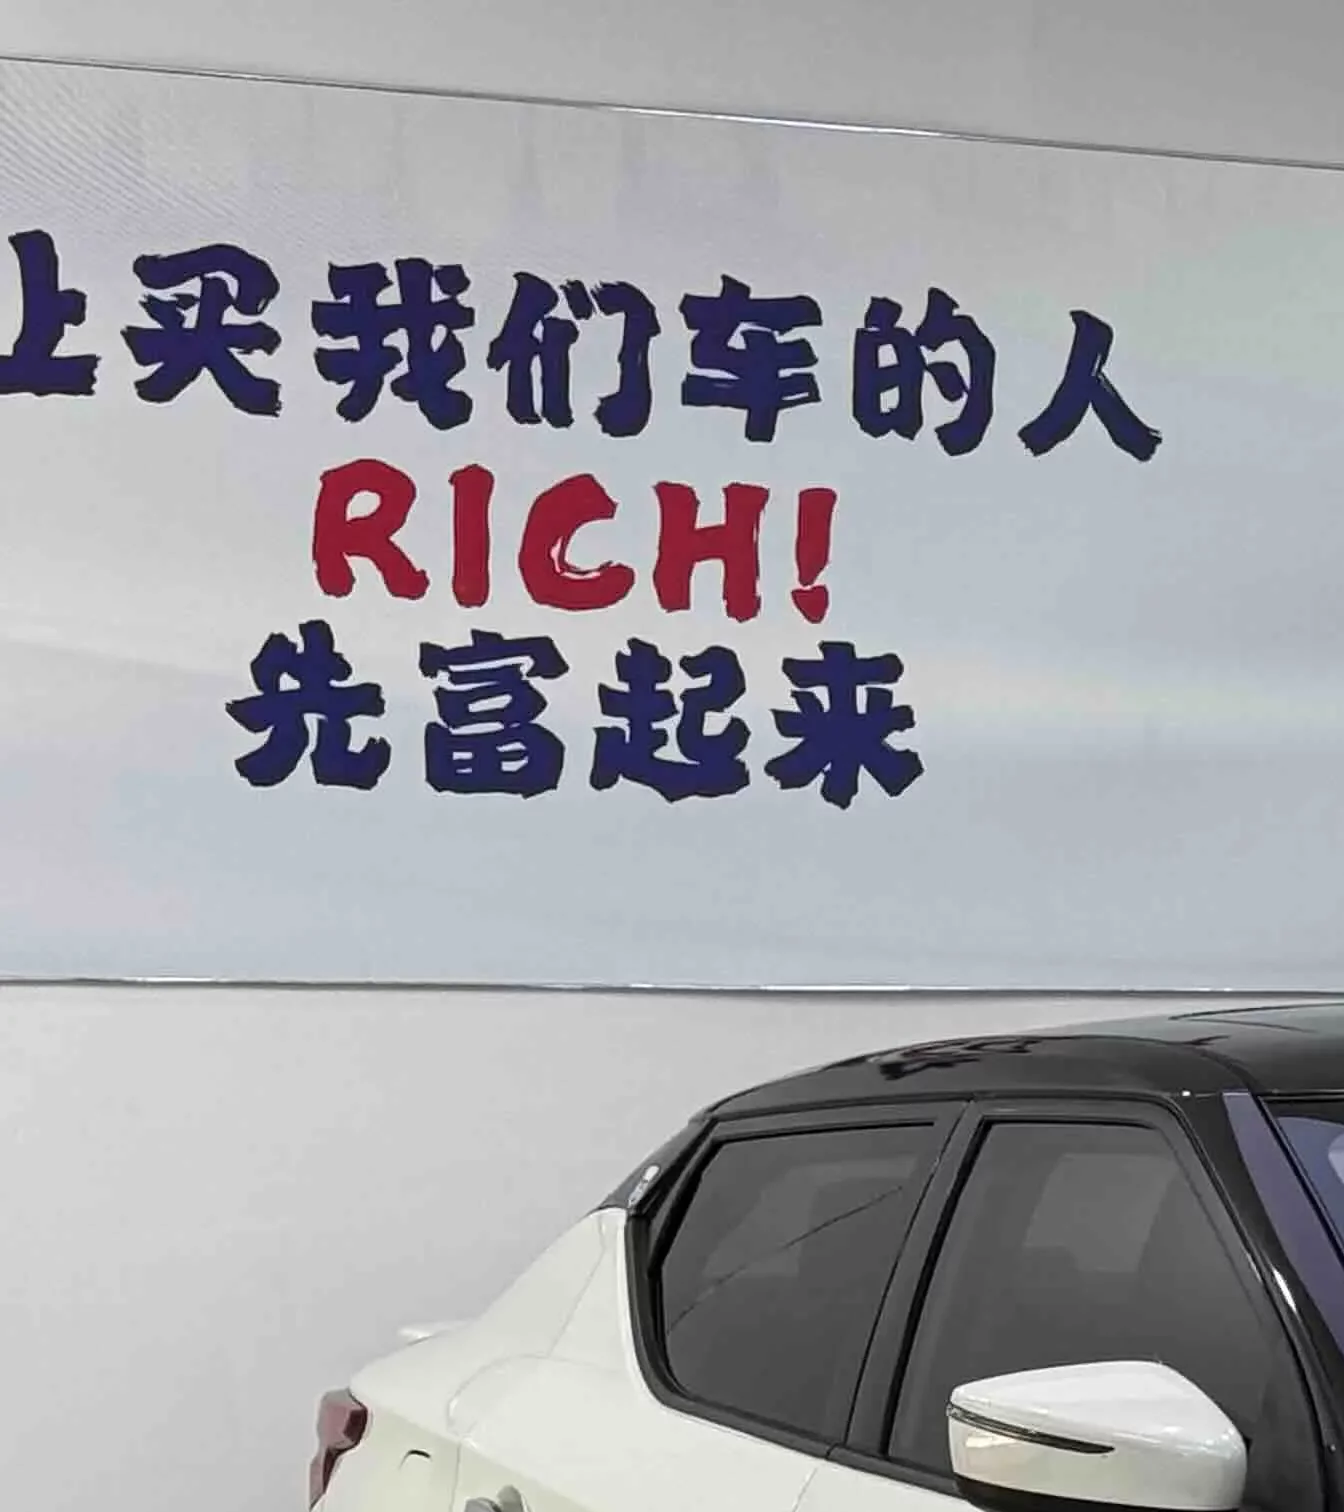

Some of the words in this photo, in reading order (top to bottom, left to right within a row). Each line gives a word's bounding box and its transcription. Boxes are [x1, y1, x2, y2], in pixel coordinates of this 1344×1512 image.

[310, 458, 838, 623] RICH!
[225, 621, 924, 808] 先富起来
